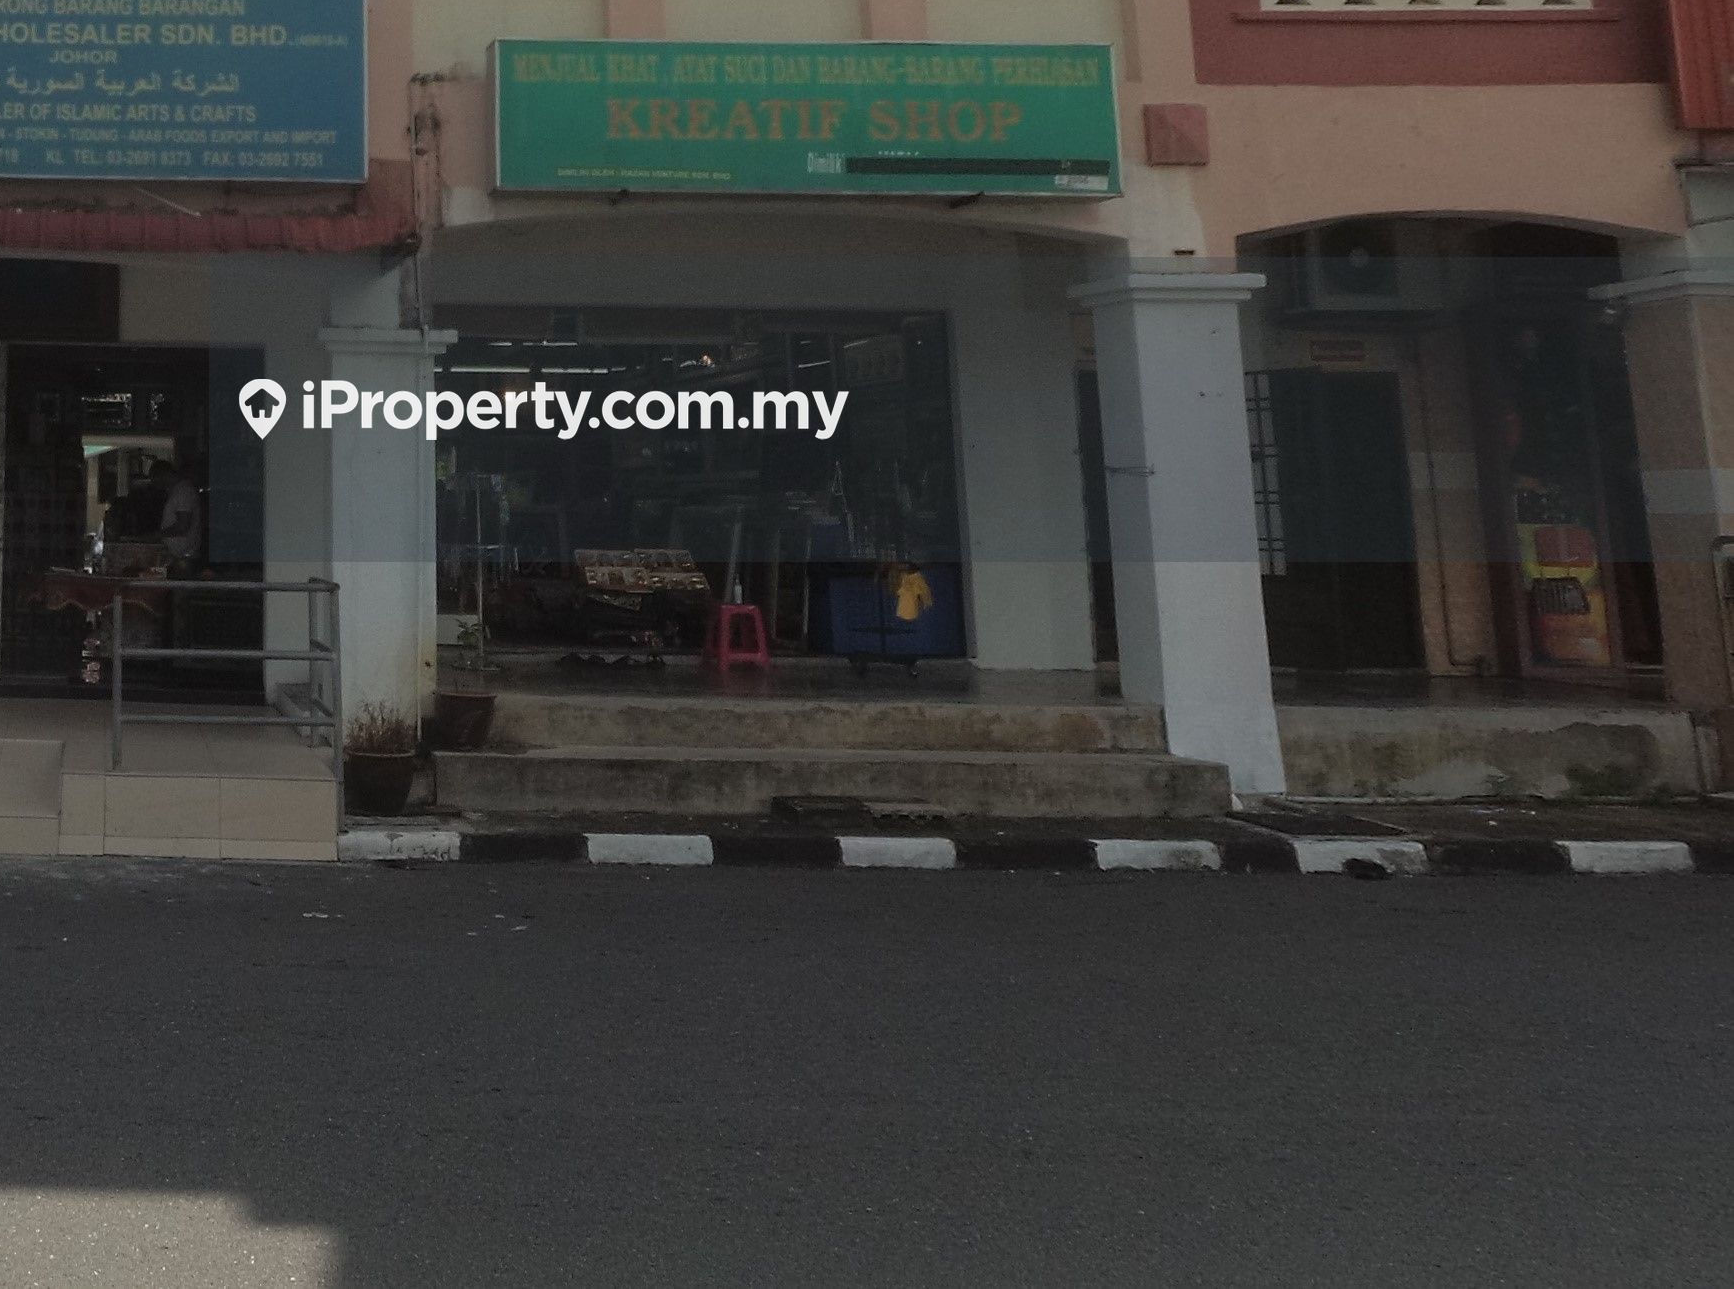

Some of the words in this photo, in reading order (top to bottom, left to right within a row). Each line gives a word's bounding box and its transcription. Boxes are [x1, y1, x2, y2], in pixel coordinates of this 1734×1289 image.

[161, 24, 221, 46] SDN.
[49, 50, 118, 64] JOHOR
[96, 68, 162, 97] العربية
[172, 68, 240, 96] الشركة
[771, 55, 811, 85] DAN
[29, 103, 51, 119] OF
[56, 103, 122, 121] ISLAMIC
[127, 104, 170, 122] ARTS
[175, 106, 187, 122] &
[191, 105, 257, 123] CRAFTS
[606, 98, 848, 142] KREATIF
[868, 98, 1025, 144] SHOP
[211, 130, 260, 144] EXPORT
[263, 131, 288, 144] AND
[291, 131, 337, 145] IMPORT
